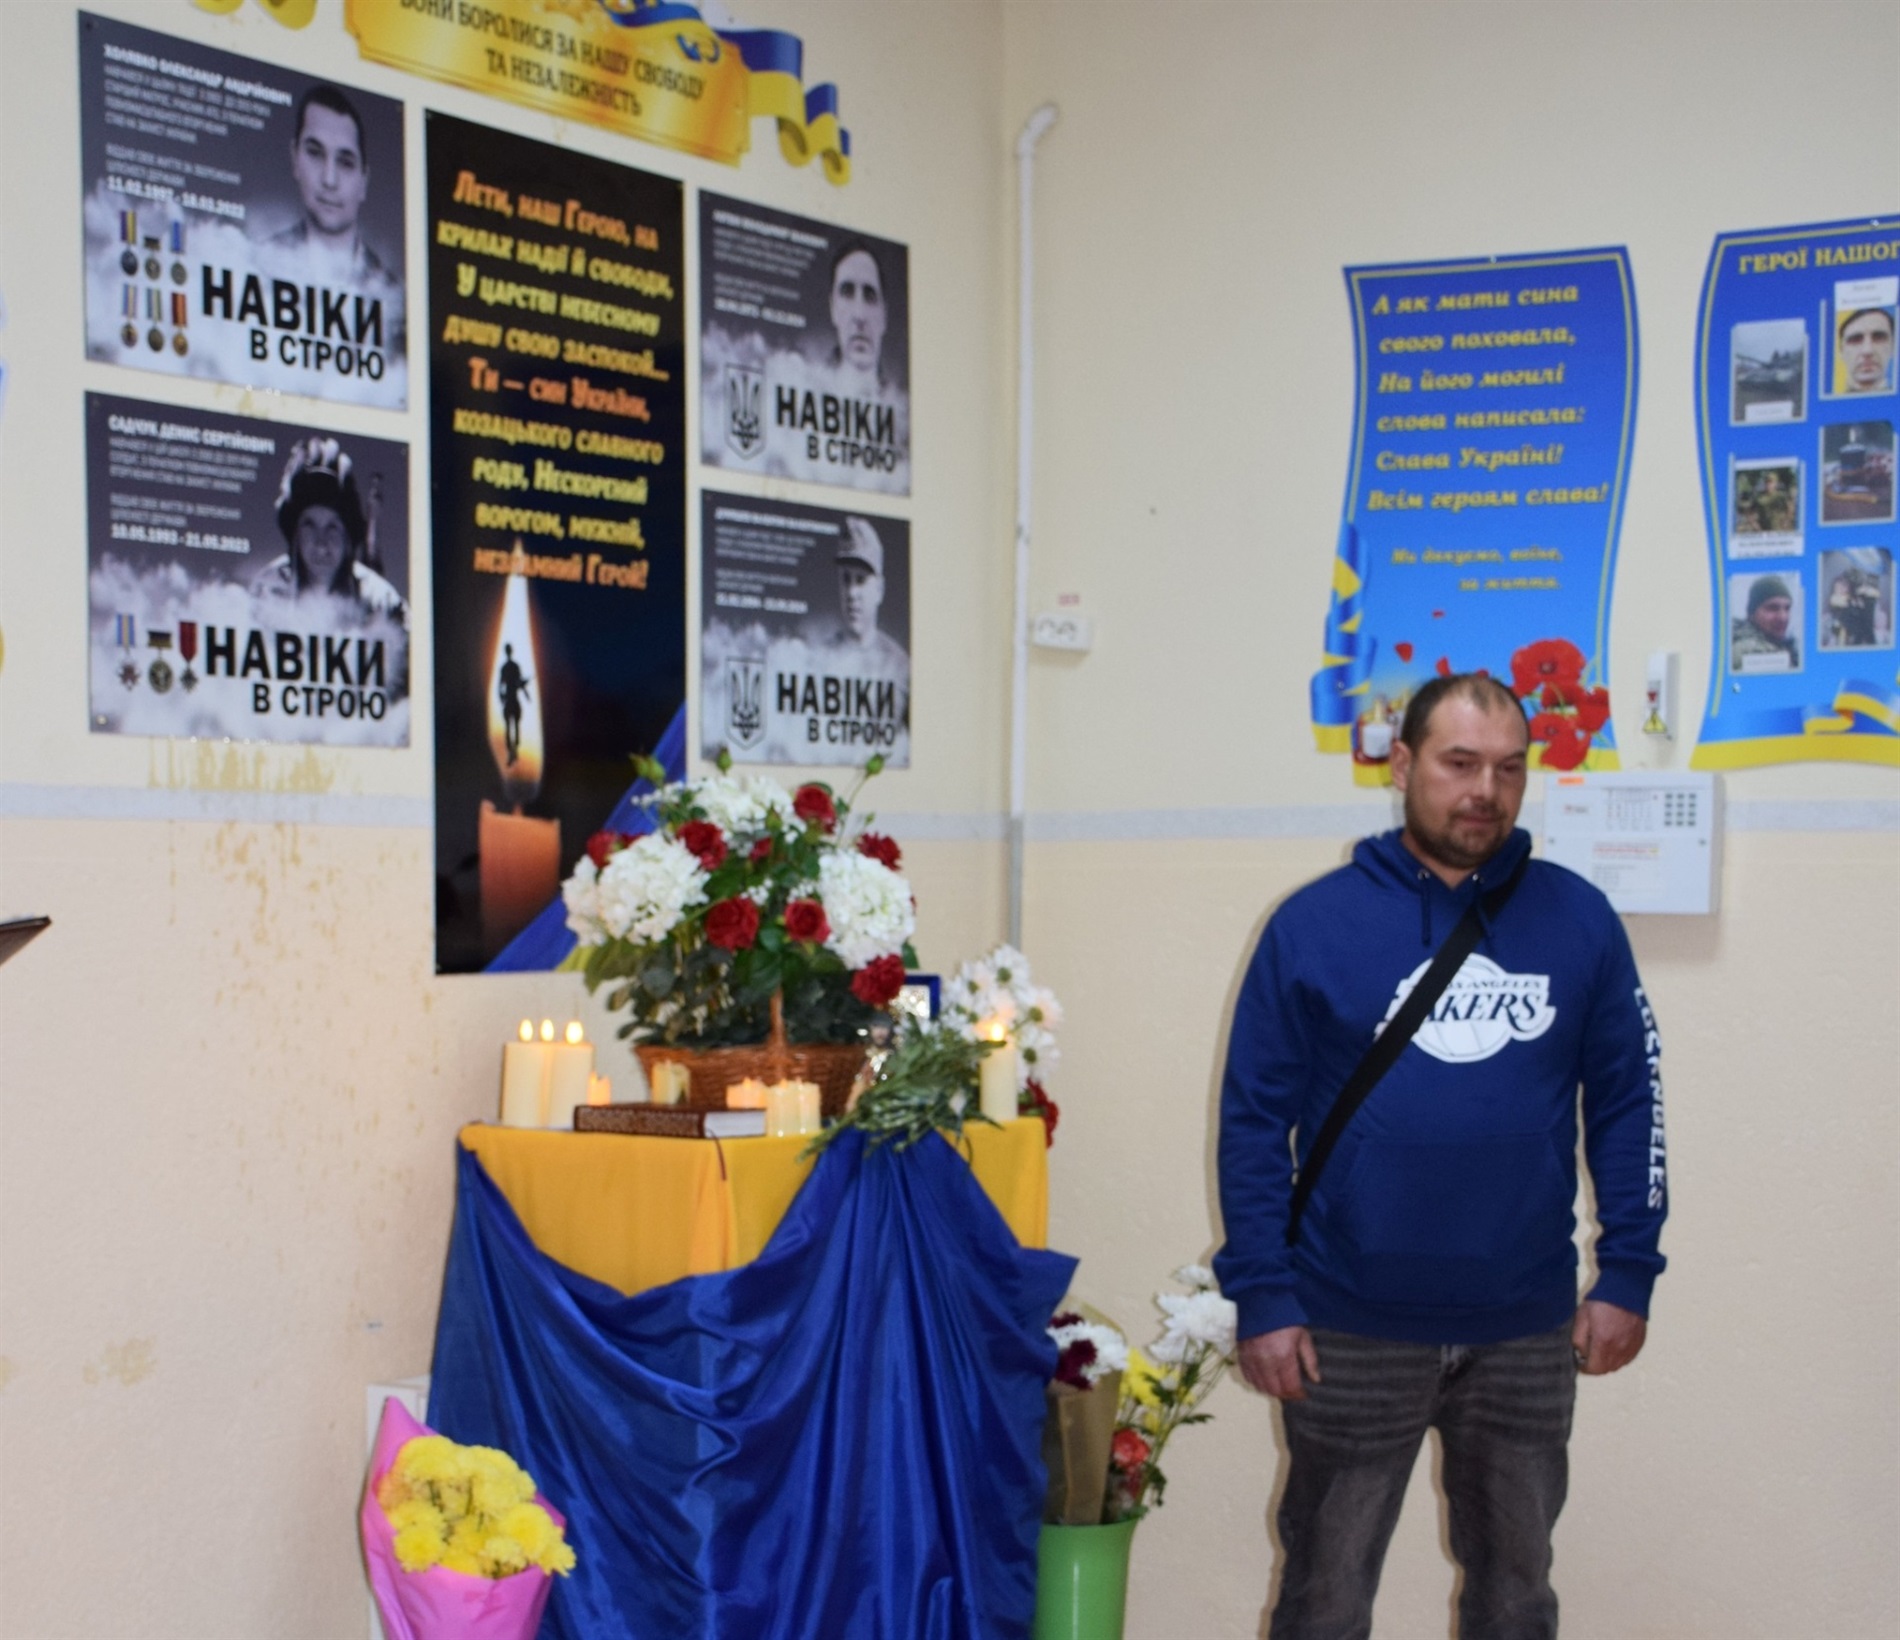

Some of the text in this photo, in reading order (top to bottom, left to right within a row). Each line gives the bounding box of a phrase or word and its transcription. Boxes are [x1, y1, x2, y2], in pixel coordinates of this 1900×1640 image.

[459, 7, 552, 47] БОРОЛИСЯ
[557, 34, 577, 59] ЗА
[581, 42, 629, 74] НАШУ
[634, 59, 705, 100] СВОБОДУ
[486, 49, 506, 76] ТА
[1739, 246, 1808, 274] ГЕРОЇ
[457, 263, 476, 296] У
[203, 265, 382, 346] НАВІКИ
[1373, 287, 1579, 314] А як мати сина
[251, 330, 384, 380] В СТРОЮ
[1380, 328, 1576, 353] свого поховала,
[1379, 363, 1565, 392] На його могилі
[777, 384, 894, 444] НАВІКИ
[1377, 407, 1585, 432] слова написала:
[808, 434, 895, 473] В СТРОЮ
[1377, 444, 1564, 472] Слава Україні!
[1368, 483, 1609, 514] Всім героям слава!
[206, 626, 385, 686] НАВІКИ
[254, 684, 385, 719] В СТРОЮ
[778, 673, 894, 719] НАВІКИ
[808, 718, 895, 746] В СТРОЮ
[1428, 993, 1540, 1032] KERS
